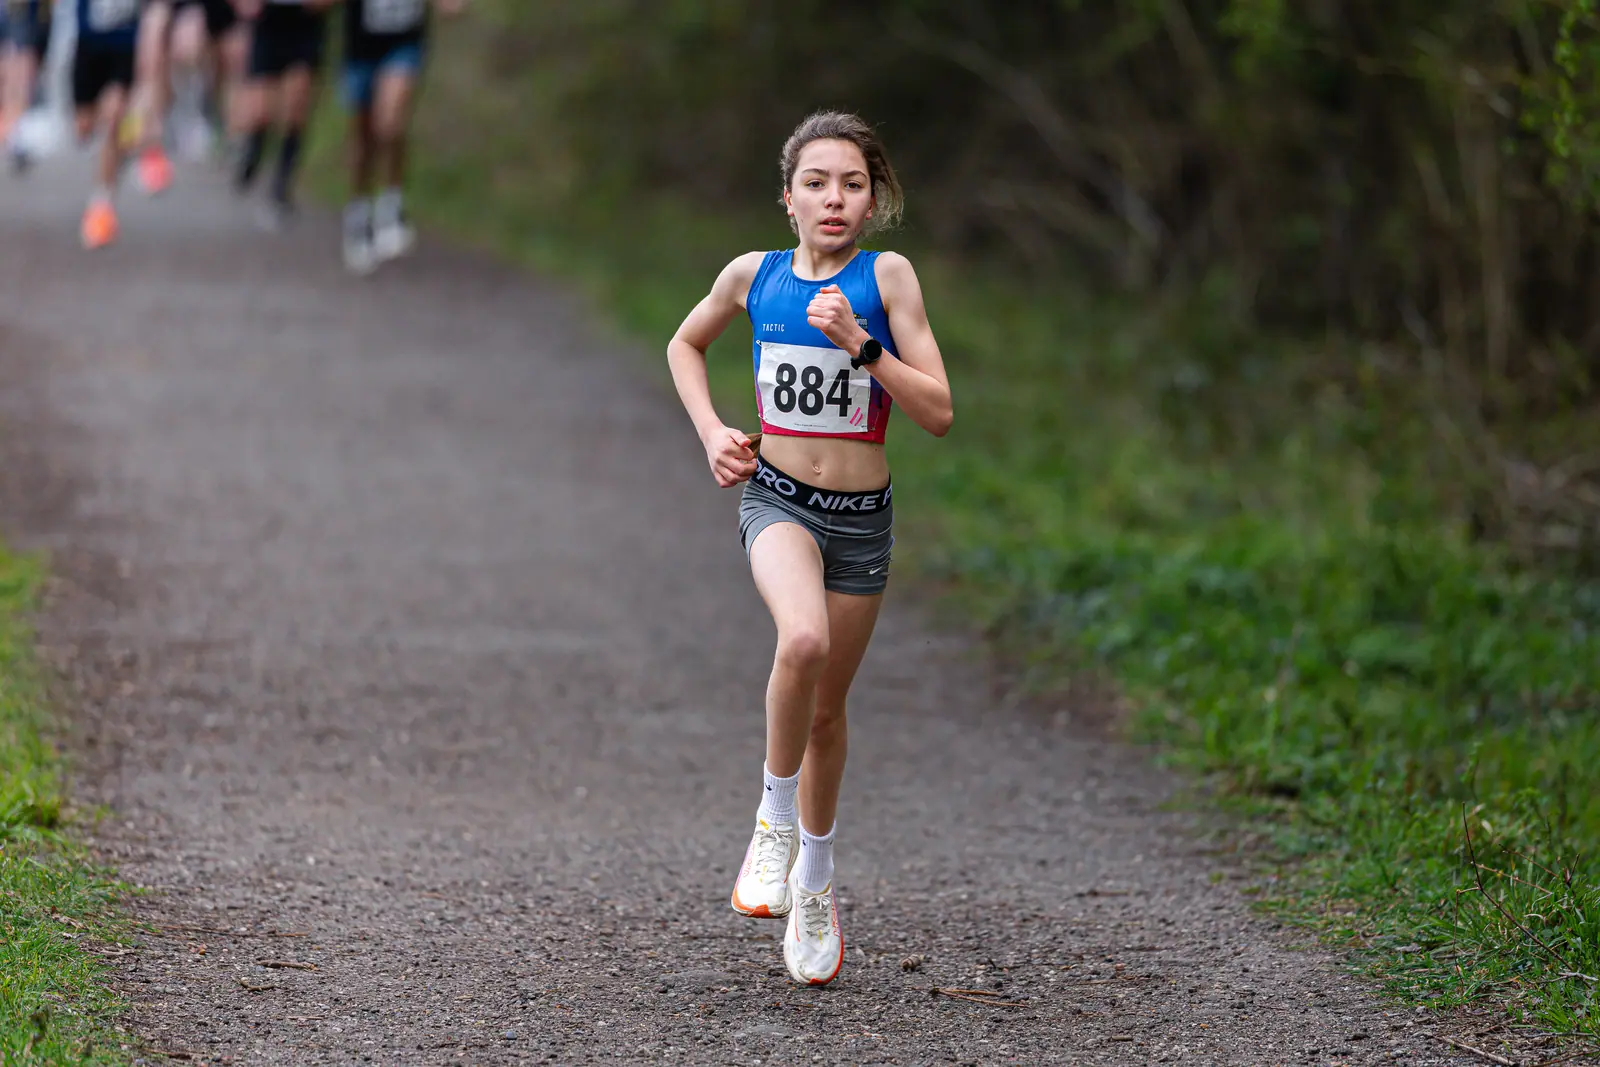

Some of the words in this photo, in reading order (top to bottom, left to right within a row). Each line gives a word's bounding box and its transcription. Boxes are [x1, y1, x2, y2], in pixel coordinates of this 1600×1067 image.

[762, 323, 785, 332] TACTIC
[774, 363, 852, 417] 884
[807, 492, 880, 511] NIKE
